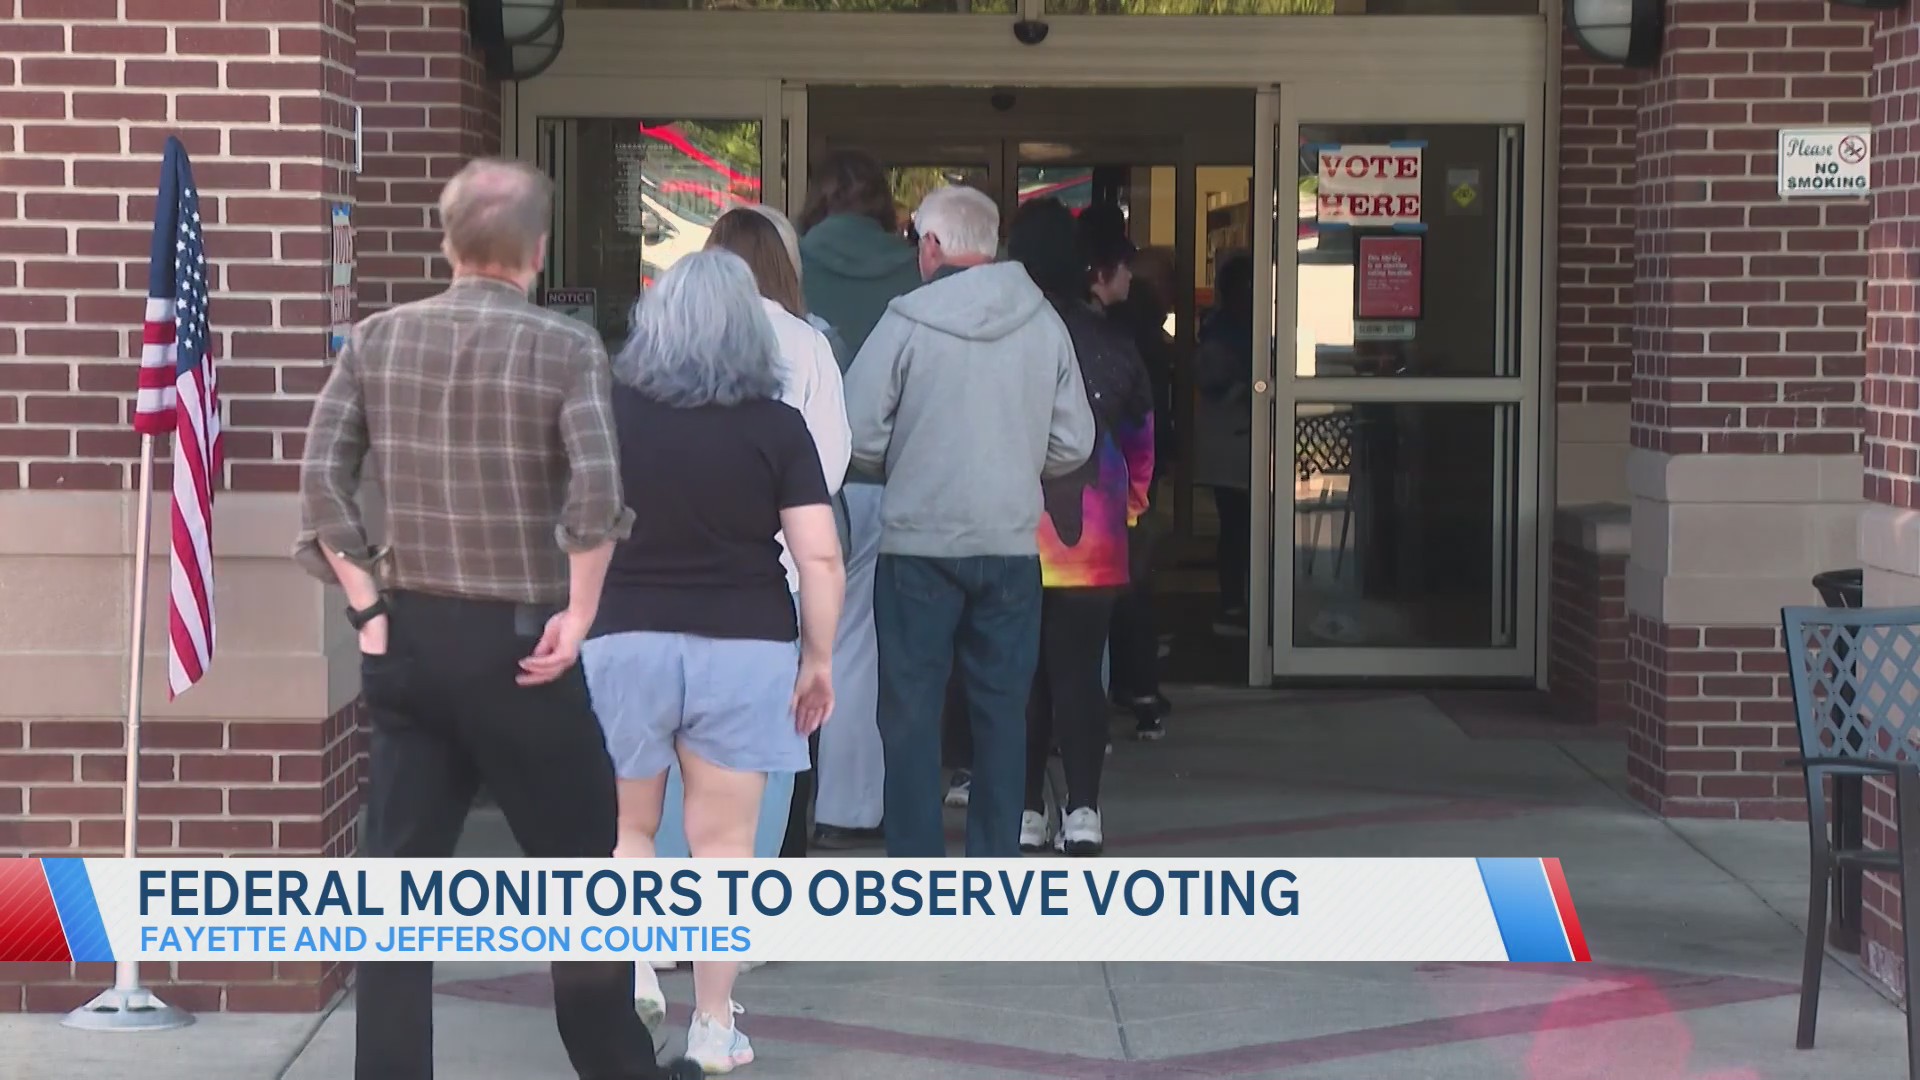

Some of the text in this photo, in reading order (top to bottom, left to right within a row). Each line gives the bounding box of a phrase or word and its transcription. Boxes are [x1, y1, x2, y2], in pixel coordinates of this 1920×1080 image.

[1786, 138, 1834, 157] Please
[1321, 155, 1418, 178] VOTE
[1815, 162, 1839, 174] NO
[1787, 175, 1867, 189] SMOKING
[1320, 193, 1419, 216] HERE
[549, 293, 592, 303] NOTICE
